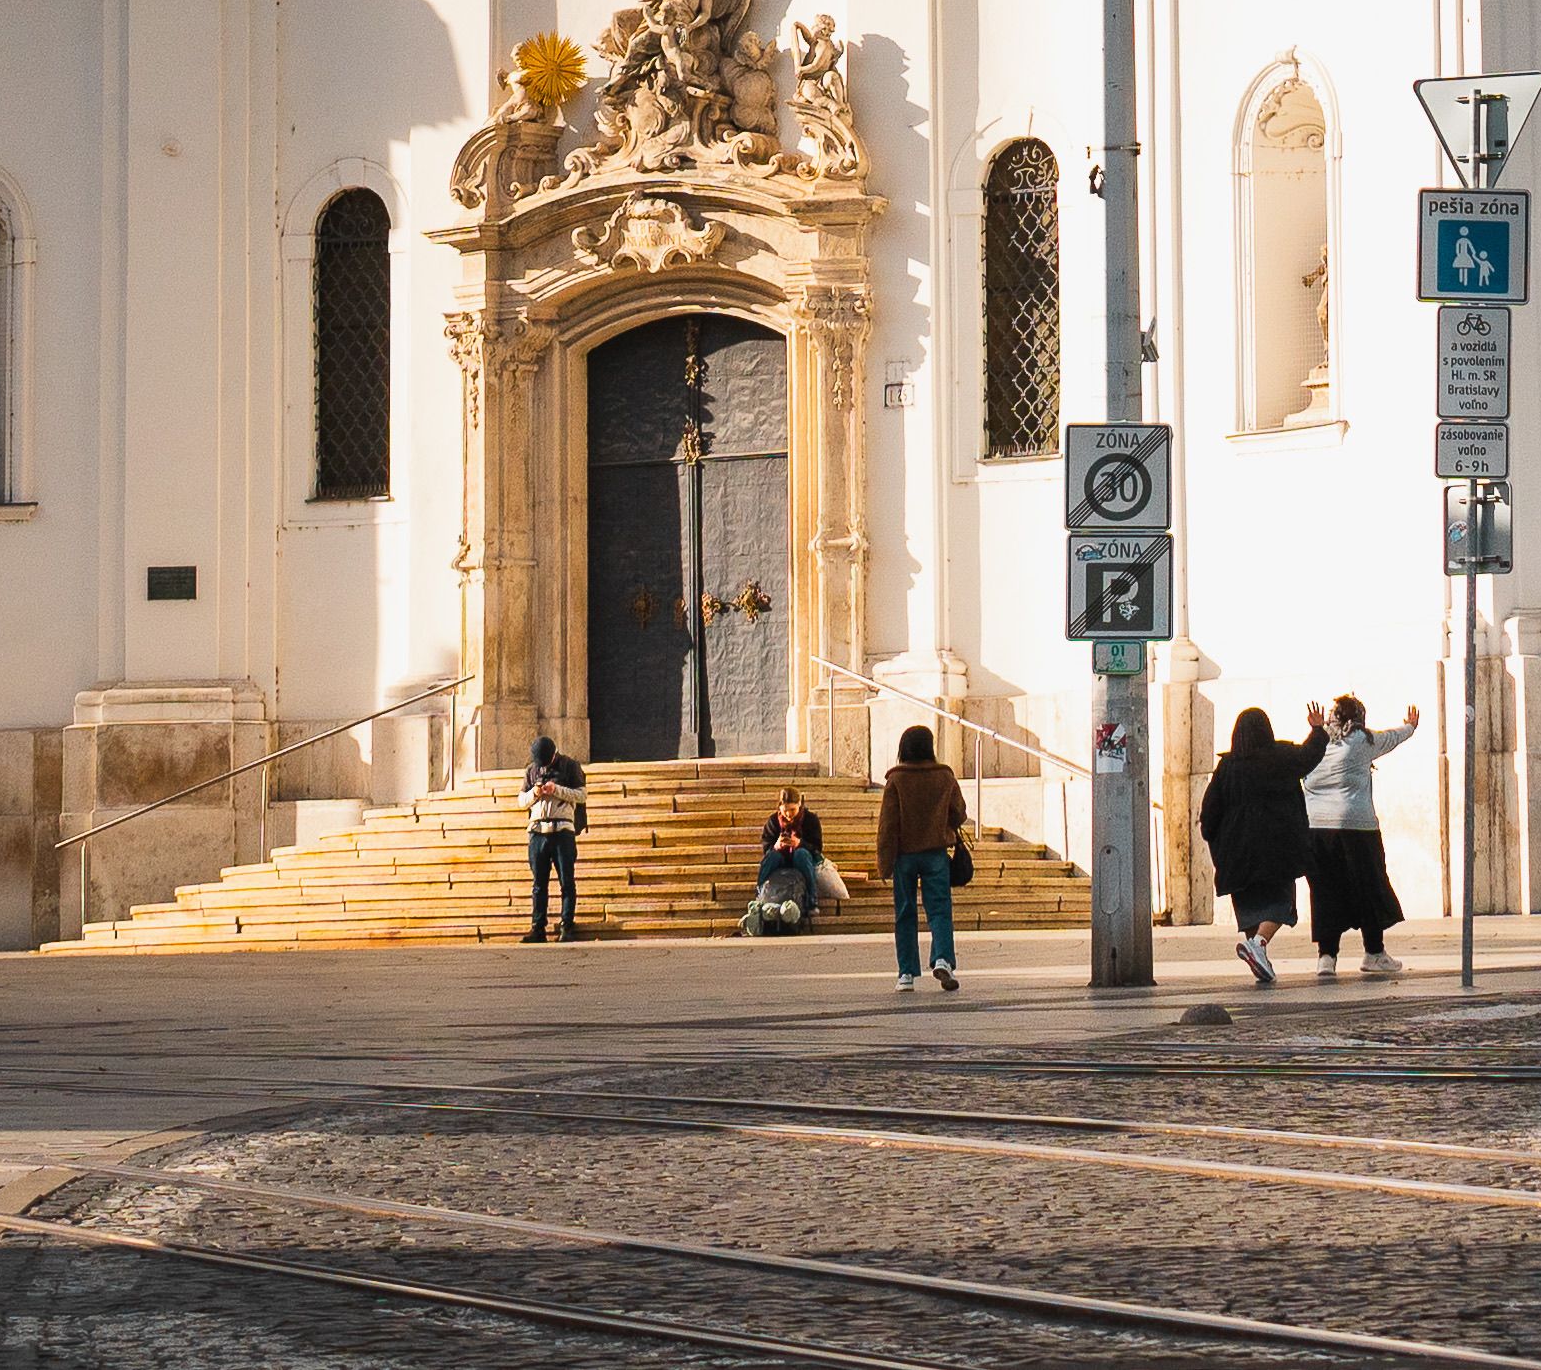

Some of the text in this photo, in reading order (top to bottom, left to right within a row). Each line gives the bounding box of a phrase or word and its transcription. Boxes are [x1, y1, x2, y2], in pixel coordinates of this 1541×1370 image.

[1428, 196, 1519, 216] pešia zóna
[1451, 340, 1497, 352] a vozidlá
[1443, 355, 1505, 368] s povolením
[1468, 372, 1480, 381] m.
[1483, 370, 1497, 381] SR
[1447, 384, 1500, 398] Bratislavy
[1459, 399, 1489, 410] voľno
[1096, 429, 1141, 449] ZÓNA
[1440, 428, 1504, 441] zásobovanie
[1458, 444, 1487, 456] voľno
[1098, 539, 1143, 559] ZÓNA
[1111, 645, 1125, 657] 01
